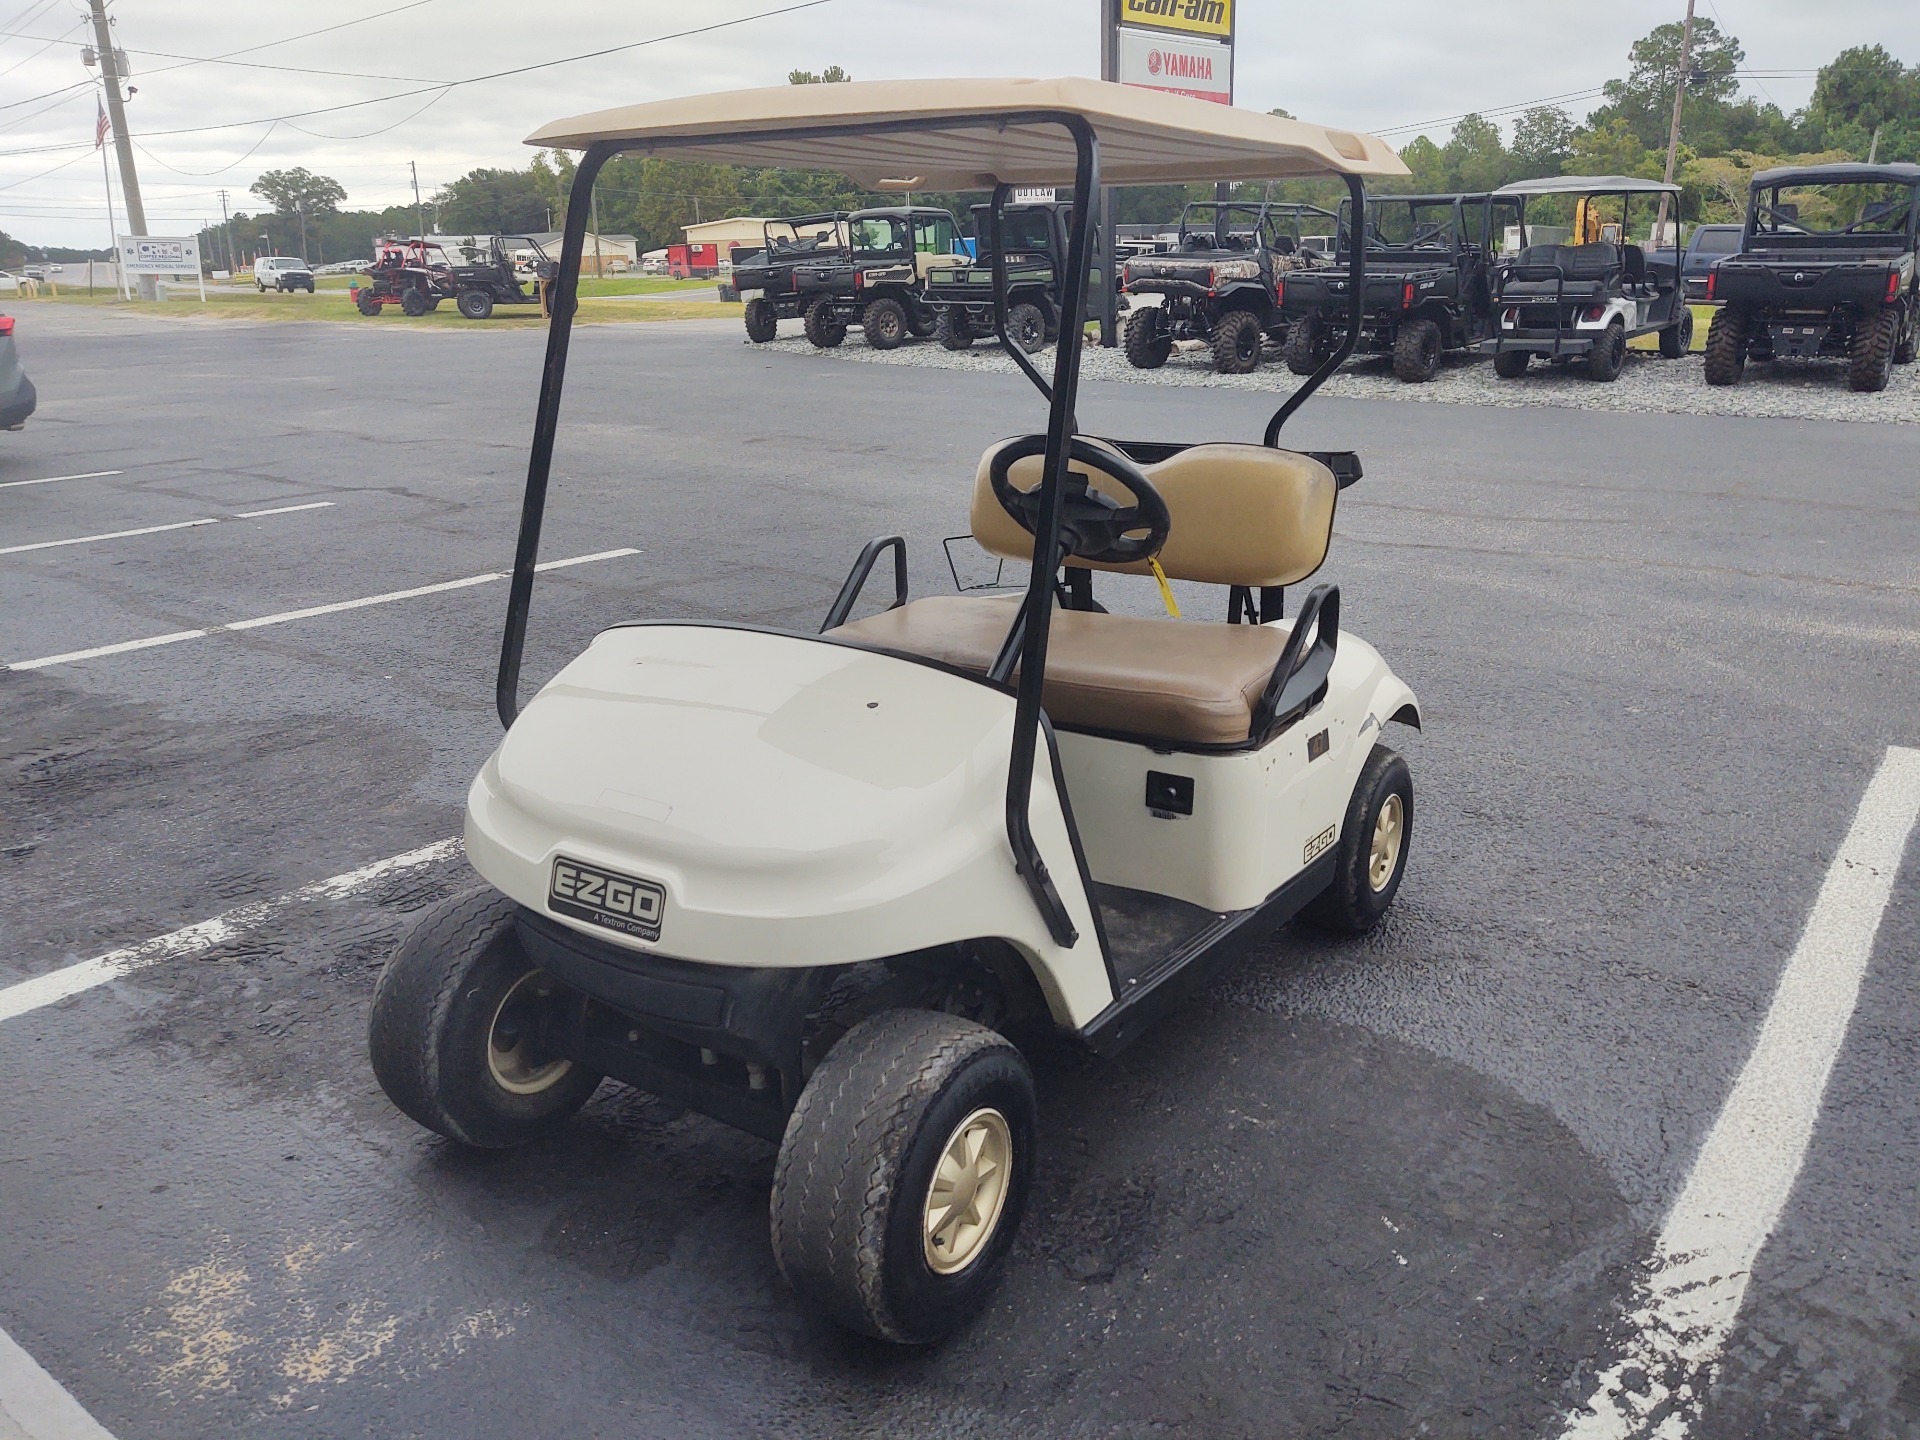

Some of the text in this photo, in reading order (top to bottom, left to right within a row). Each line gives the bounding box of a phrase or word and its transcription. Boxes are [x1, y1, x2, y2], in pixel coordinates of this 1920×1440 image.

[1162, 51, 1213, 80] YAMAHA
[1017, 187, 1053, 197] OUTLAW
[554, 864, 661, 921] EZGO
[593, 912, 660, 940] A Textron Company
